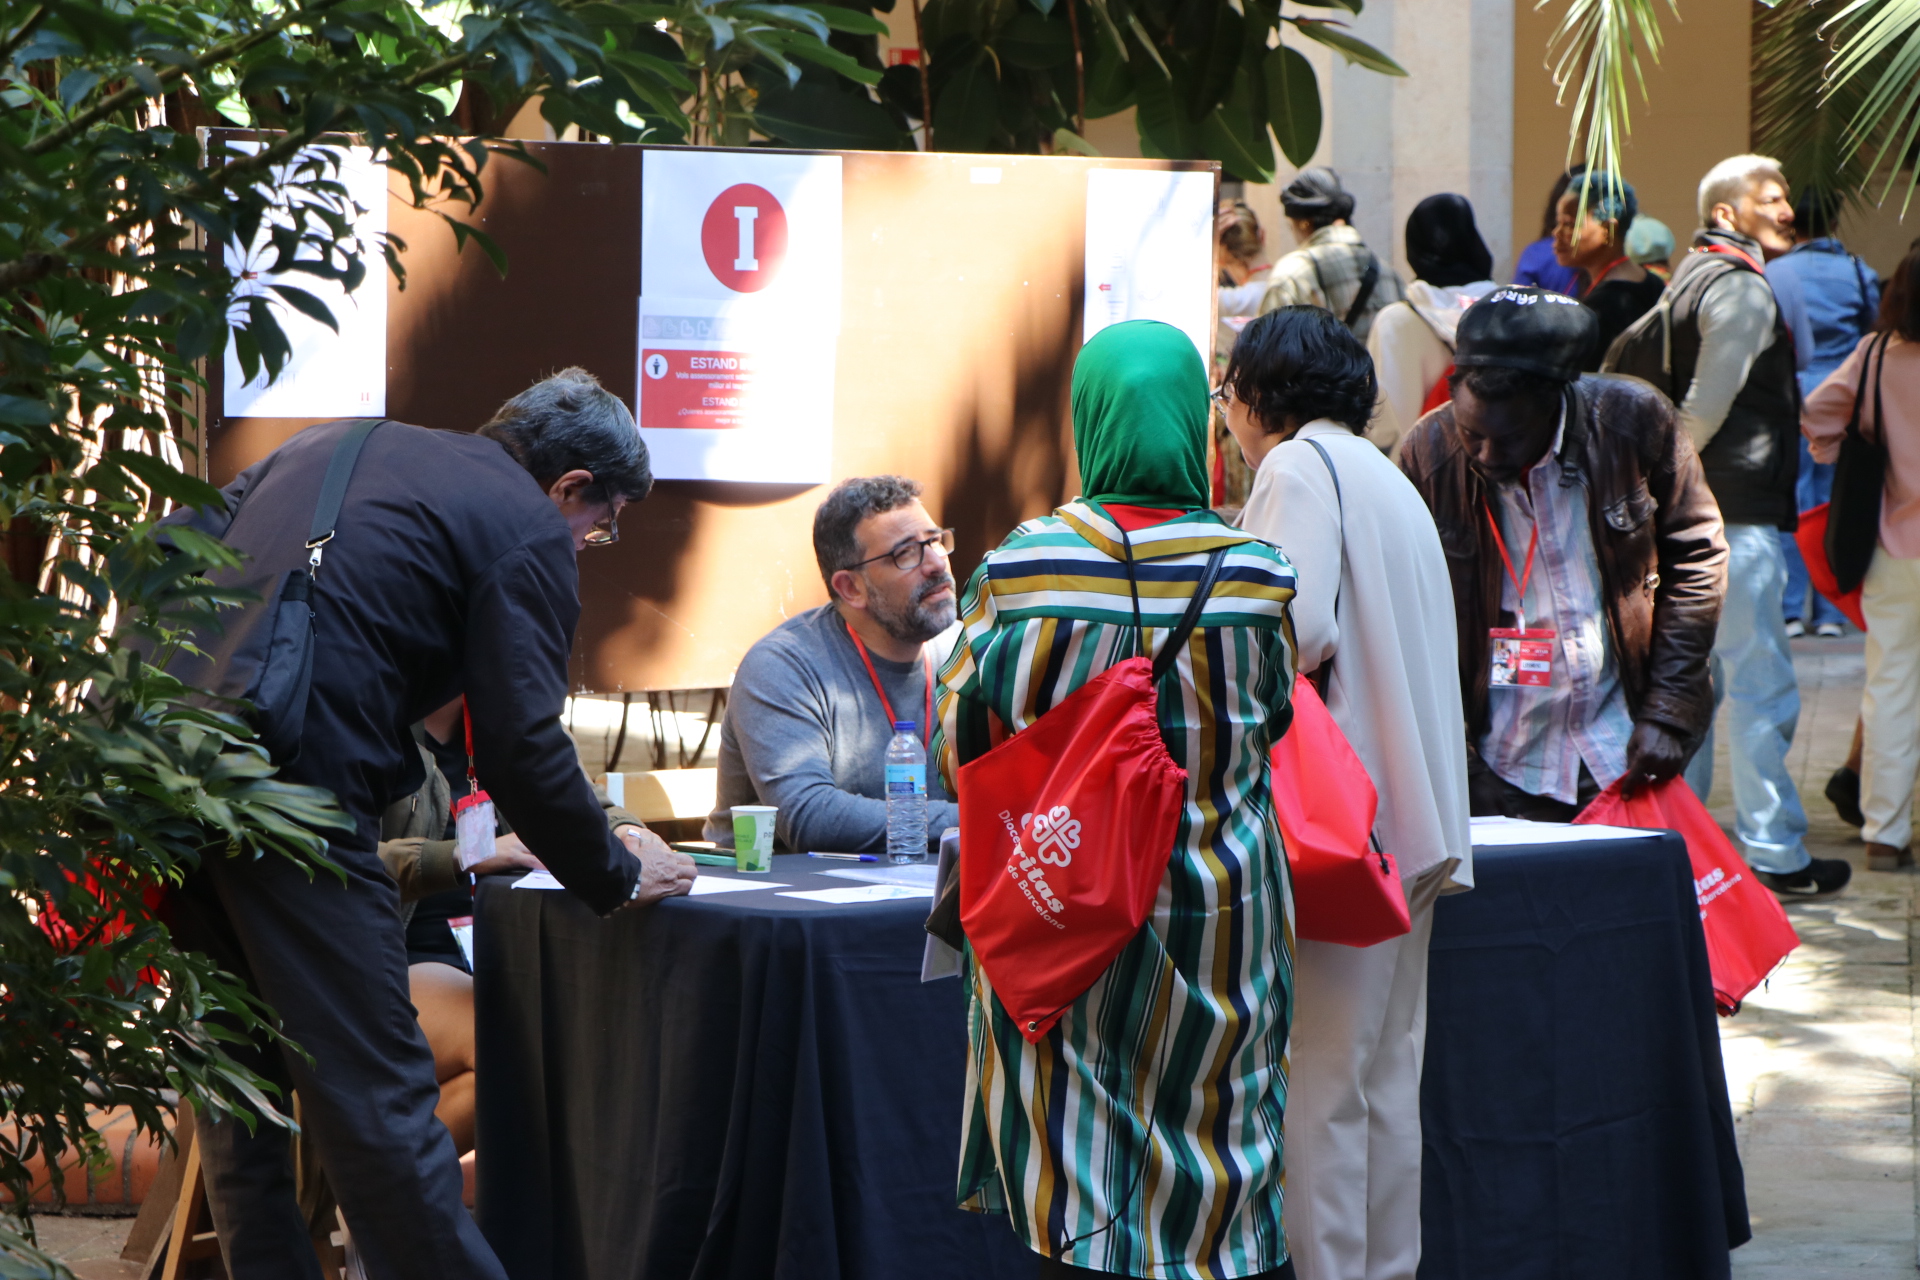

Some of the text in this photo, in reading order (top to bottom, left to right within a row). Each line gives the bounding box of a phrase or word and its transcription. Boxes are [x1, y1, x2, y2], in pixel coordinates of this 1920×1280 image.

[734, 206, 758, 271] I
[691, 357, 738, 370] ESTAND
[702, 397, 739, 406] ESTAND
[1007, 864, 1066, 930] de Barcelona
[1701, 873, 1742, 905] Barcelona
